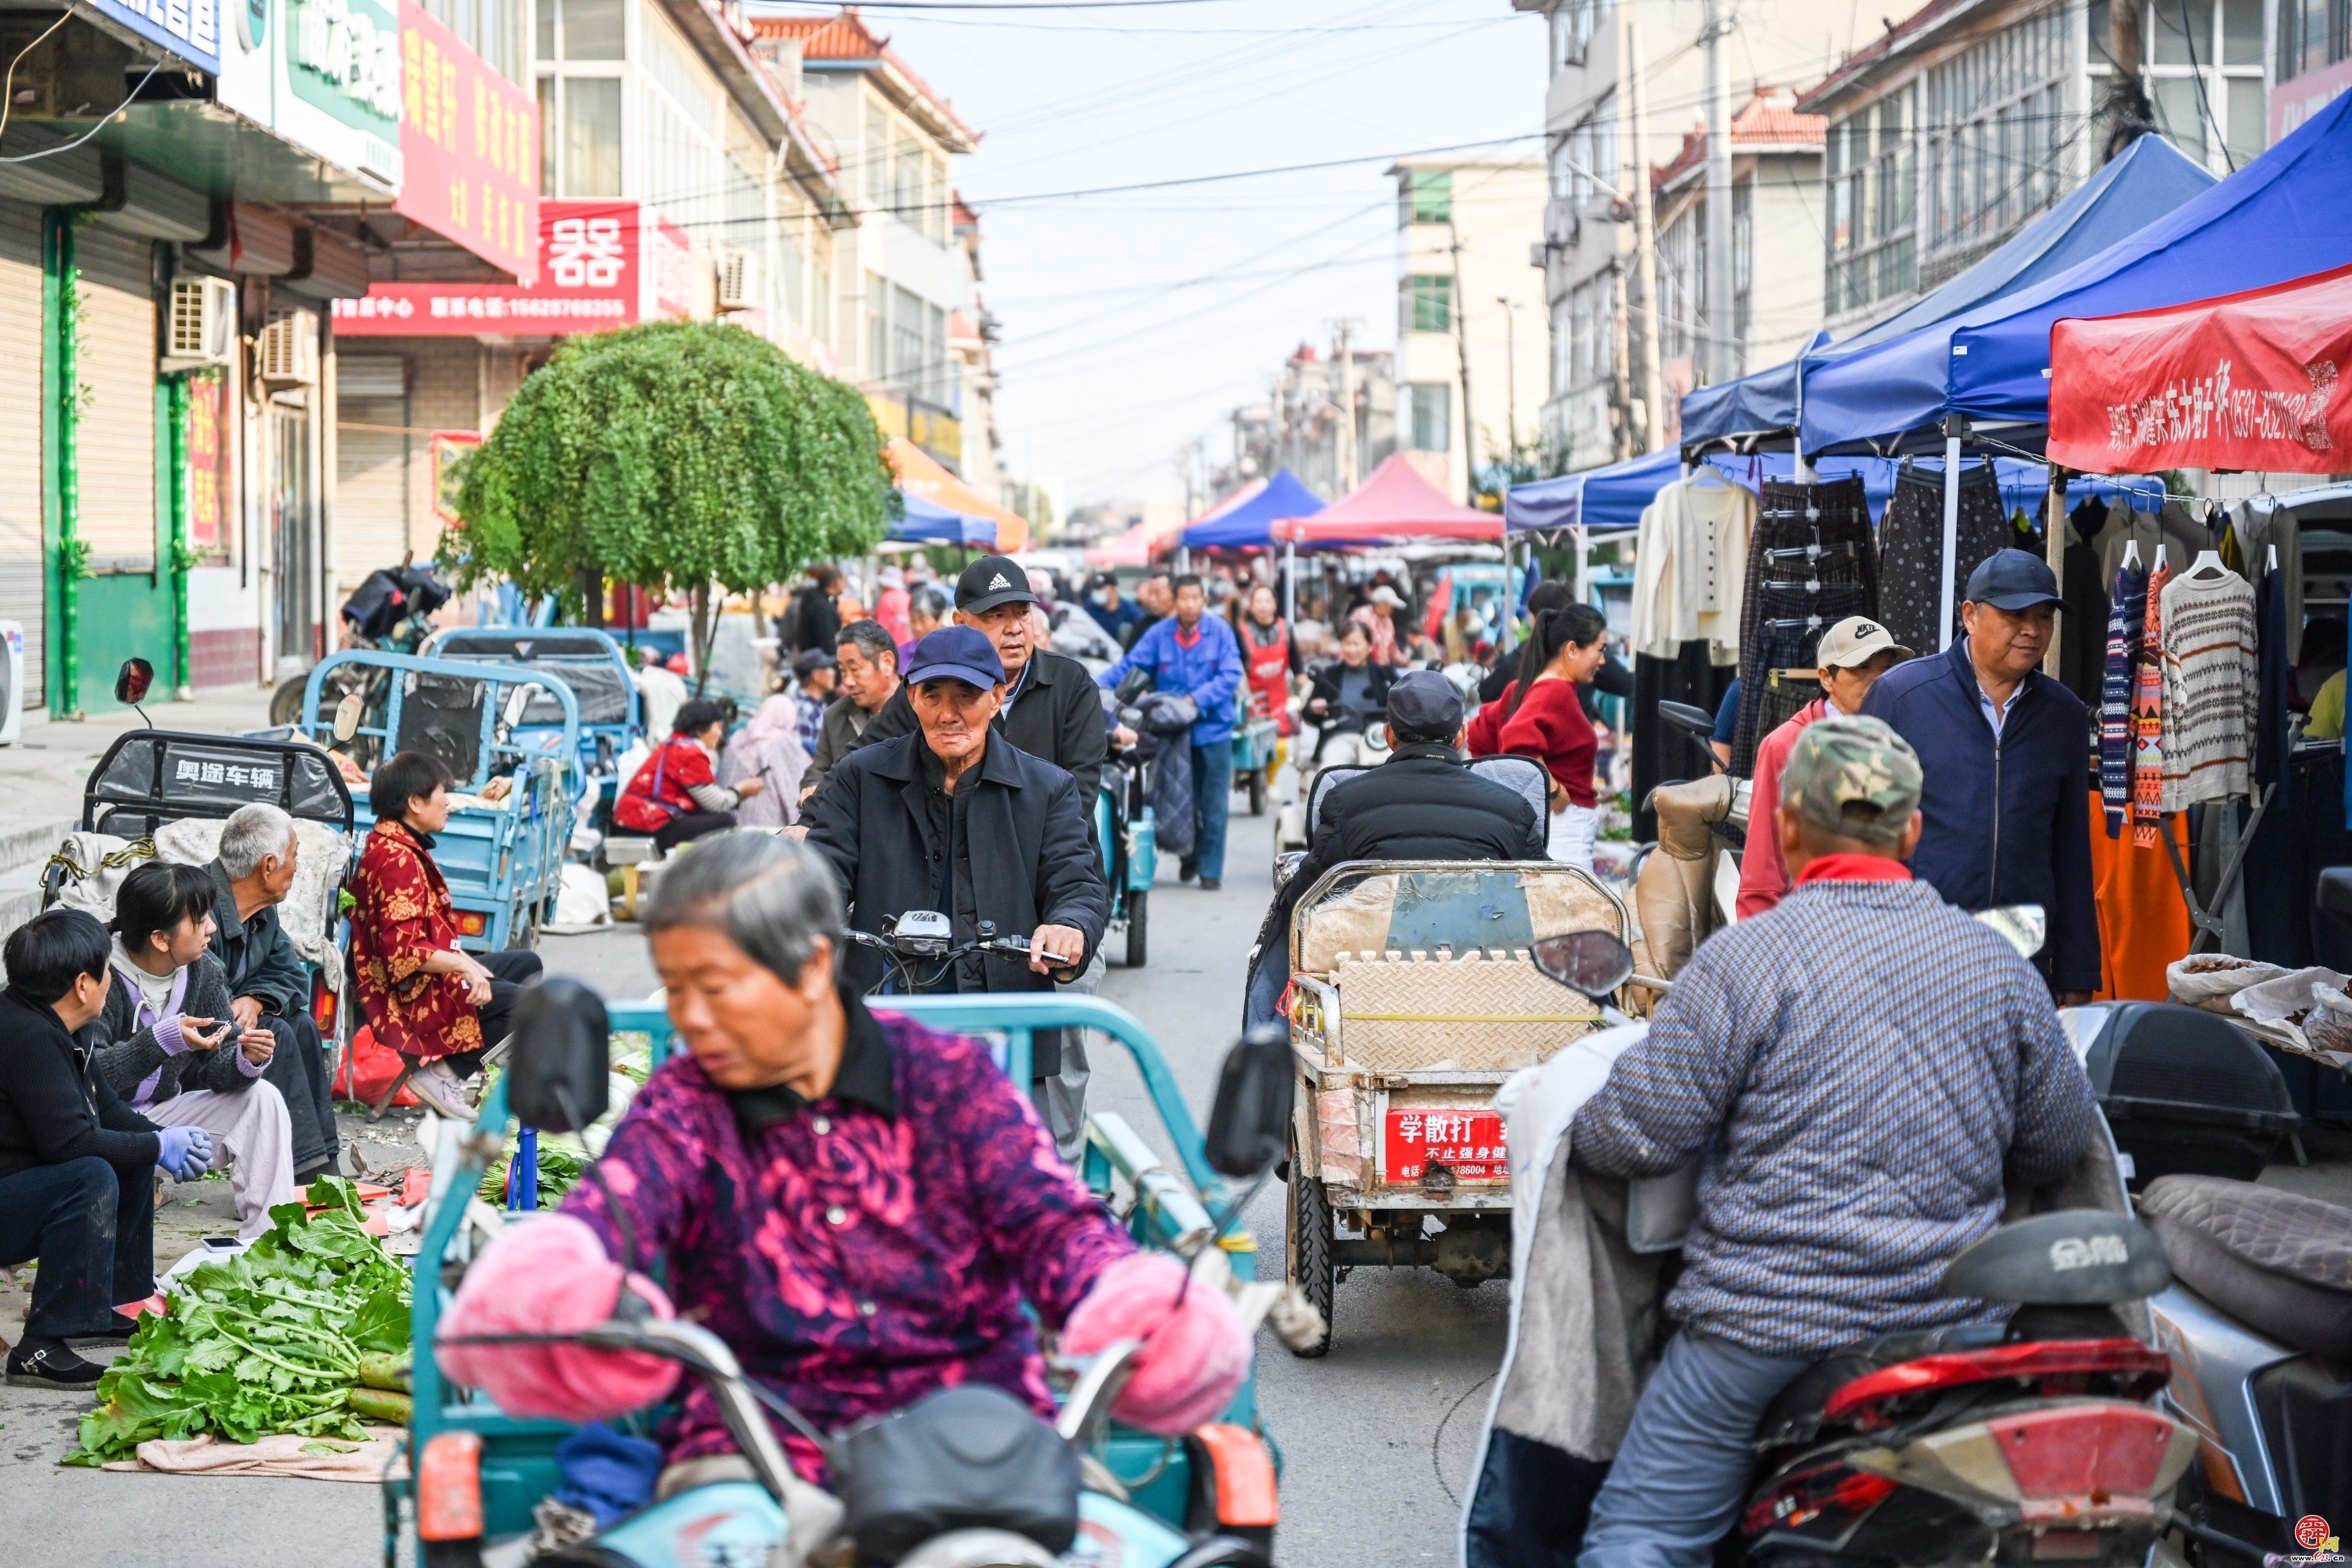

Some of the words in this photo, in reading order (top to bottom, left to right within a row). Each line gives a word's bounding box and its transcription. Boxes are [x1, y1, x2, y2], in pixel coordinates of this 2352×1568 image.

[547, 218, 626, 287] 器
[988, 582, 1011, 590] adidas
[176, 760, 274, 789] 奥途车辆
[1399, 1115, 1474, 1144] 学散打
[1424, 1146, 1507, 1160] 不止强身健
